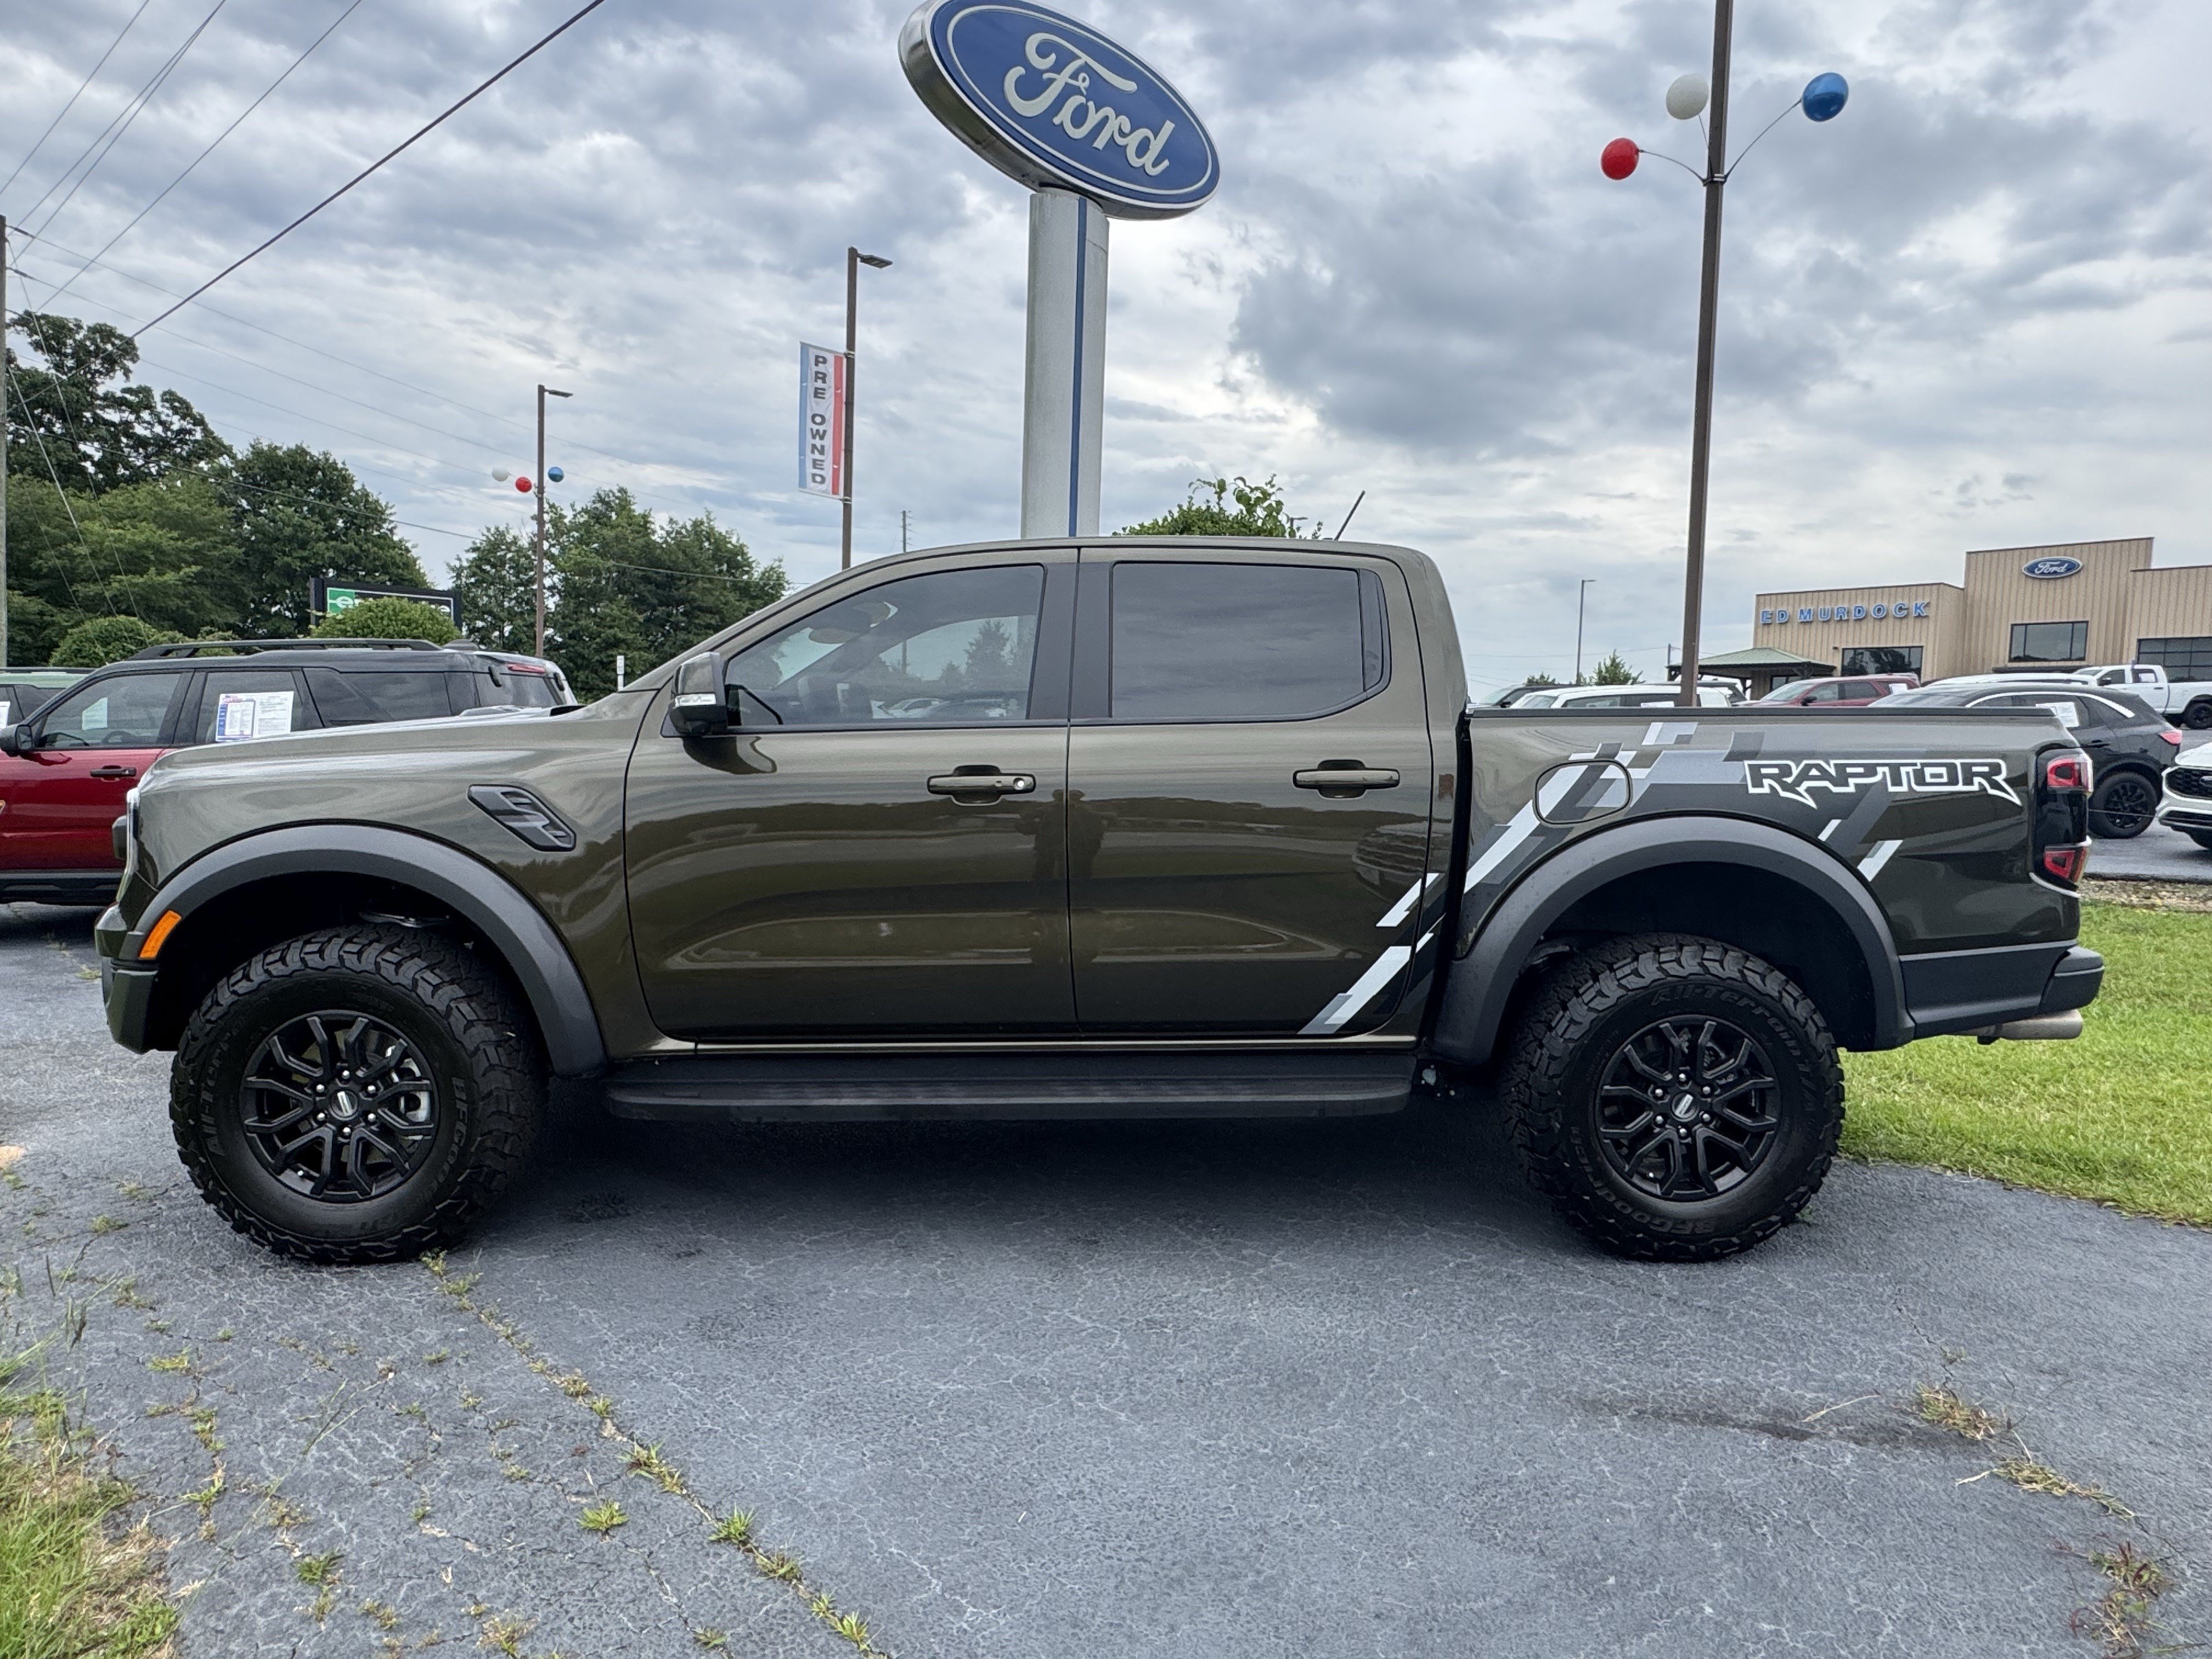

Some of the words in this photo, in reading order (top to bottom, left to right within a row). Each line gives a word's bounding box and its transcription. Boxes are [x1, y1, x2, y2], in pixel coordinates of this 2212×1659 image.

[1003, 32, 1175, 176] Ford
[813, 354, 828, 400] PRE
[810, 413, 827, 485] OWNED
[2034, 561, 2068, 574] Ford
[1760, 609, 1790, 624] ED
[1798, 601, 1929, 622] MURDOCK
[1743, 759, 2022, 810] RAPTOR
